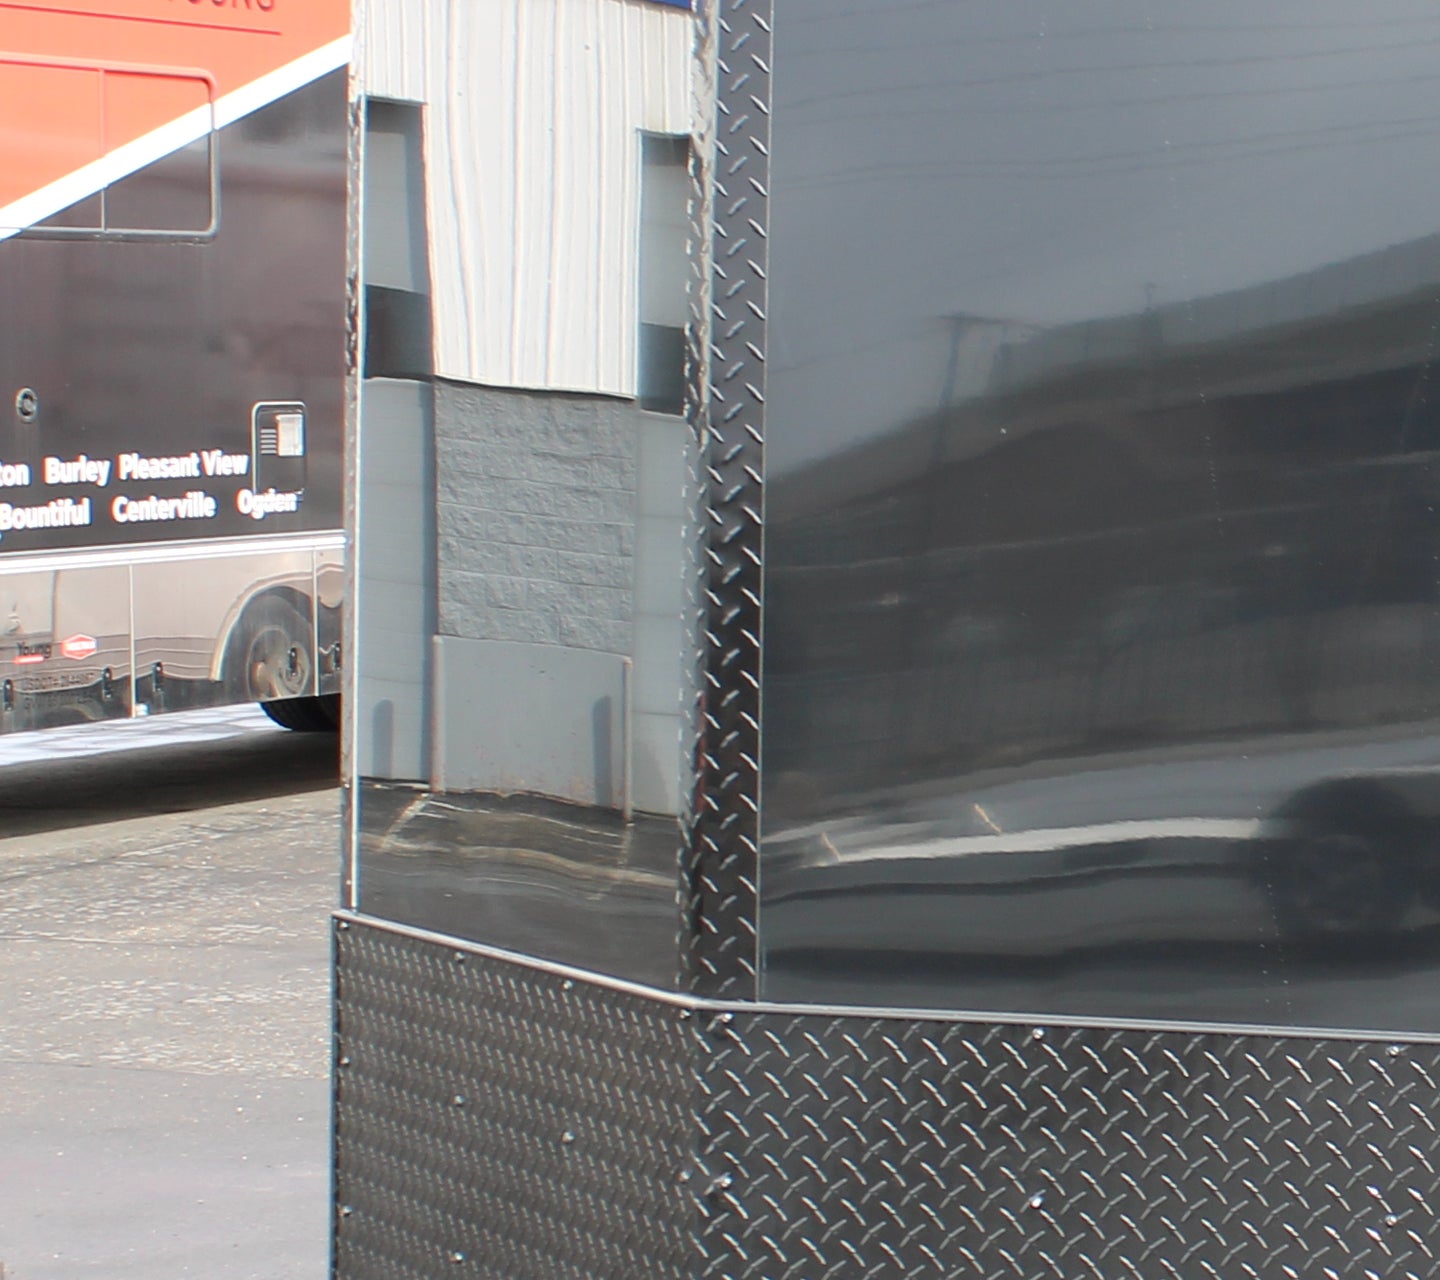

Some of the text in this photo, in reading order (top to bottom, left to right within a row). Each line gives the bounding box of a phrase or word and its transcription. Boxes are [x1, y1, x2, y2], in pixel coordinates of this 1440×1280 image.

[43, 455, 110, 488] Burley
[118, 452, 200, 480] Pleasant
[202, 450, 249, 477] View
[112, 491, 217, 524] Centerville
[236, 488, 298, 520] Ogden
